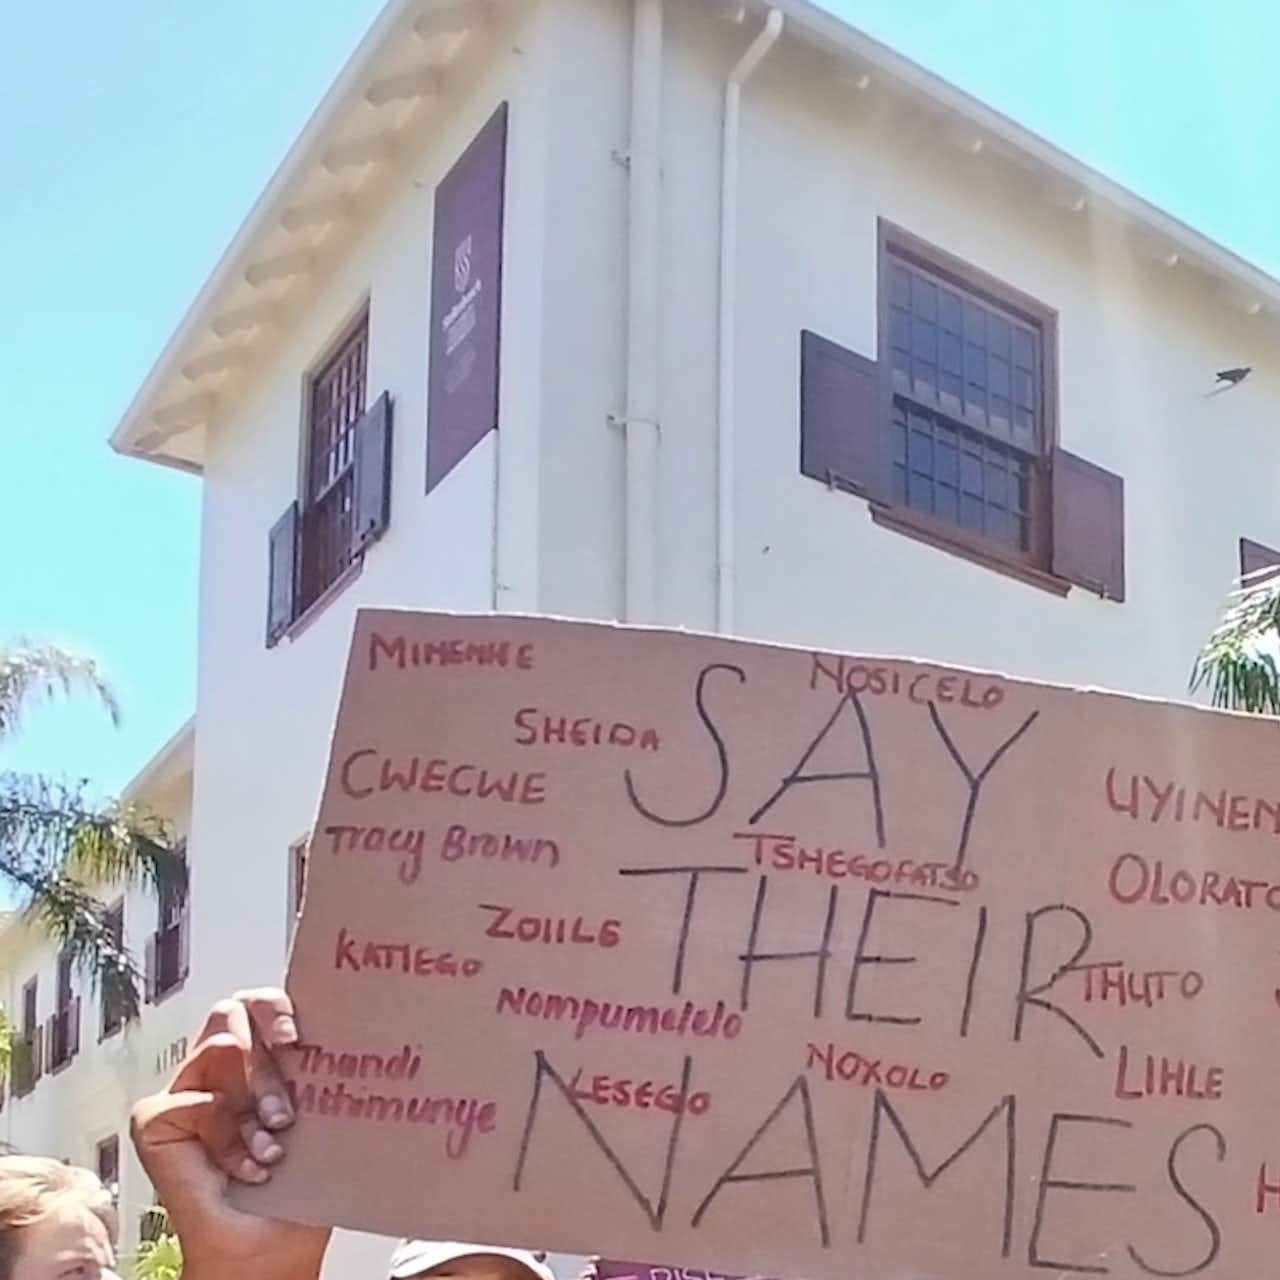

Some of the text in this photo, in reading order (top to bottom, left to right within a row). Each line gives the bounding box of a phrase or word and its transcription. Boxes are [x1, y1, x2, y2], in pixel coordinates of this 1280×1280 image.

[342, 748, 546, 804] CWECWE
[625, 663, 1040, 872] SAY
[325, 825, 560, 884] Tracy Brown
[619, 865, 1105, 1058] THEIR
[1063, 961, 1204, 1007] THUTO
[569, 1067, 711, 1116] LESEGO
[806, 1042, 951, 1090] NOXOLO
[1114, 1045, 1224, 1099] LIHLE
[513, 1049, 1227, 1277] NAMES
